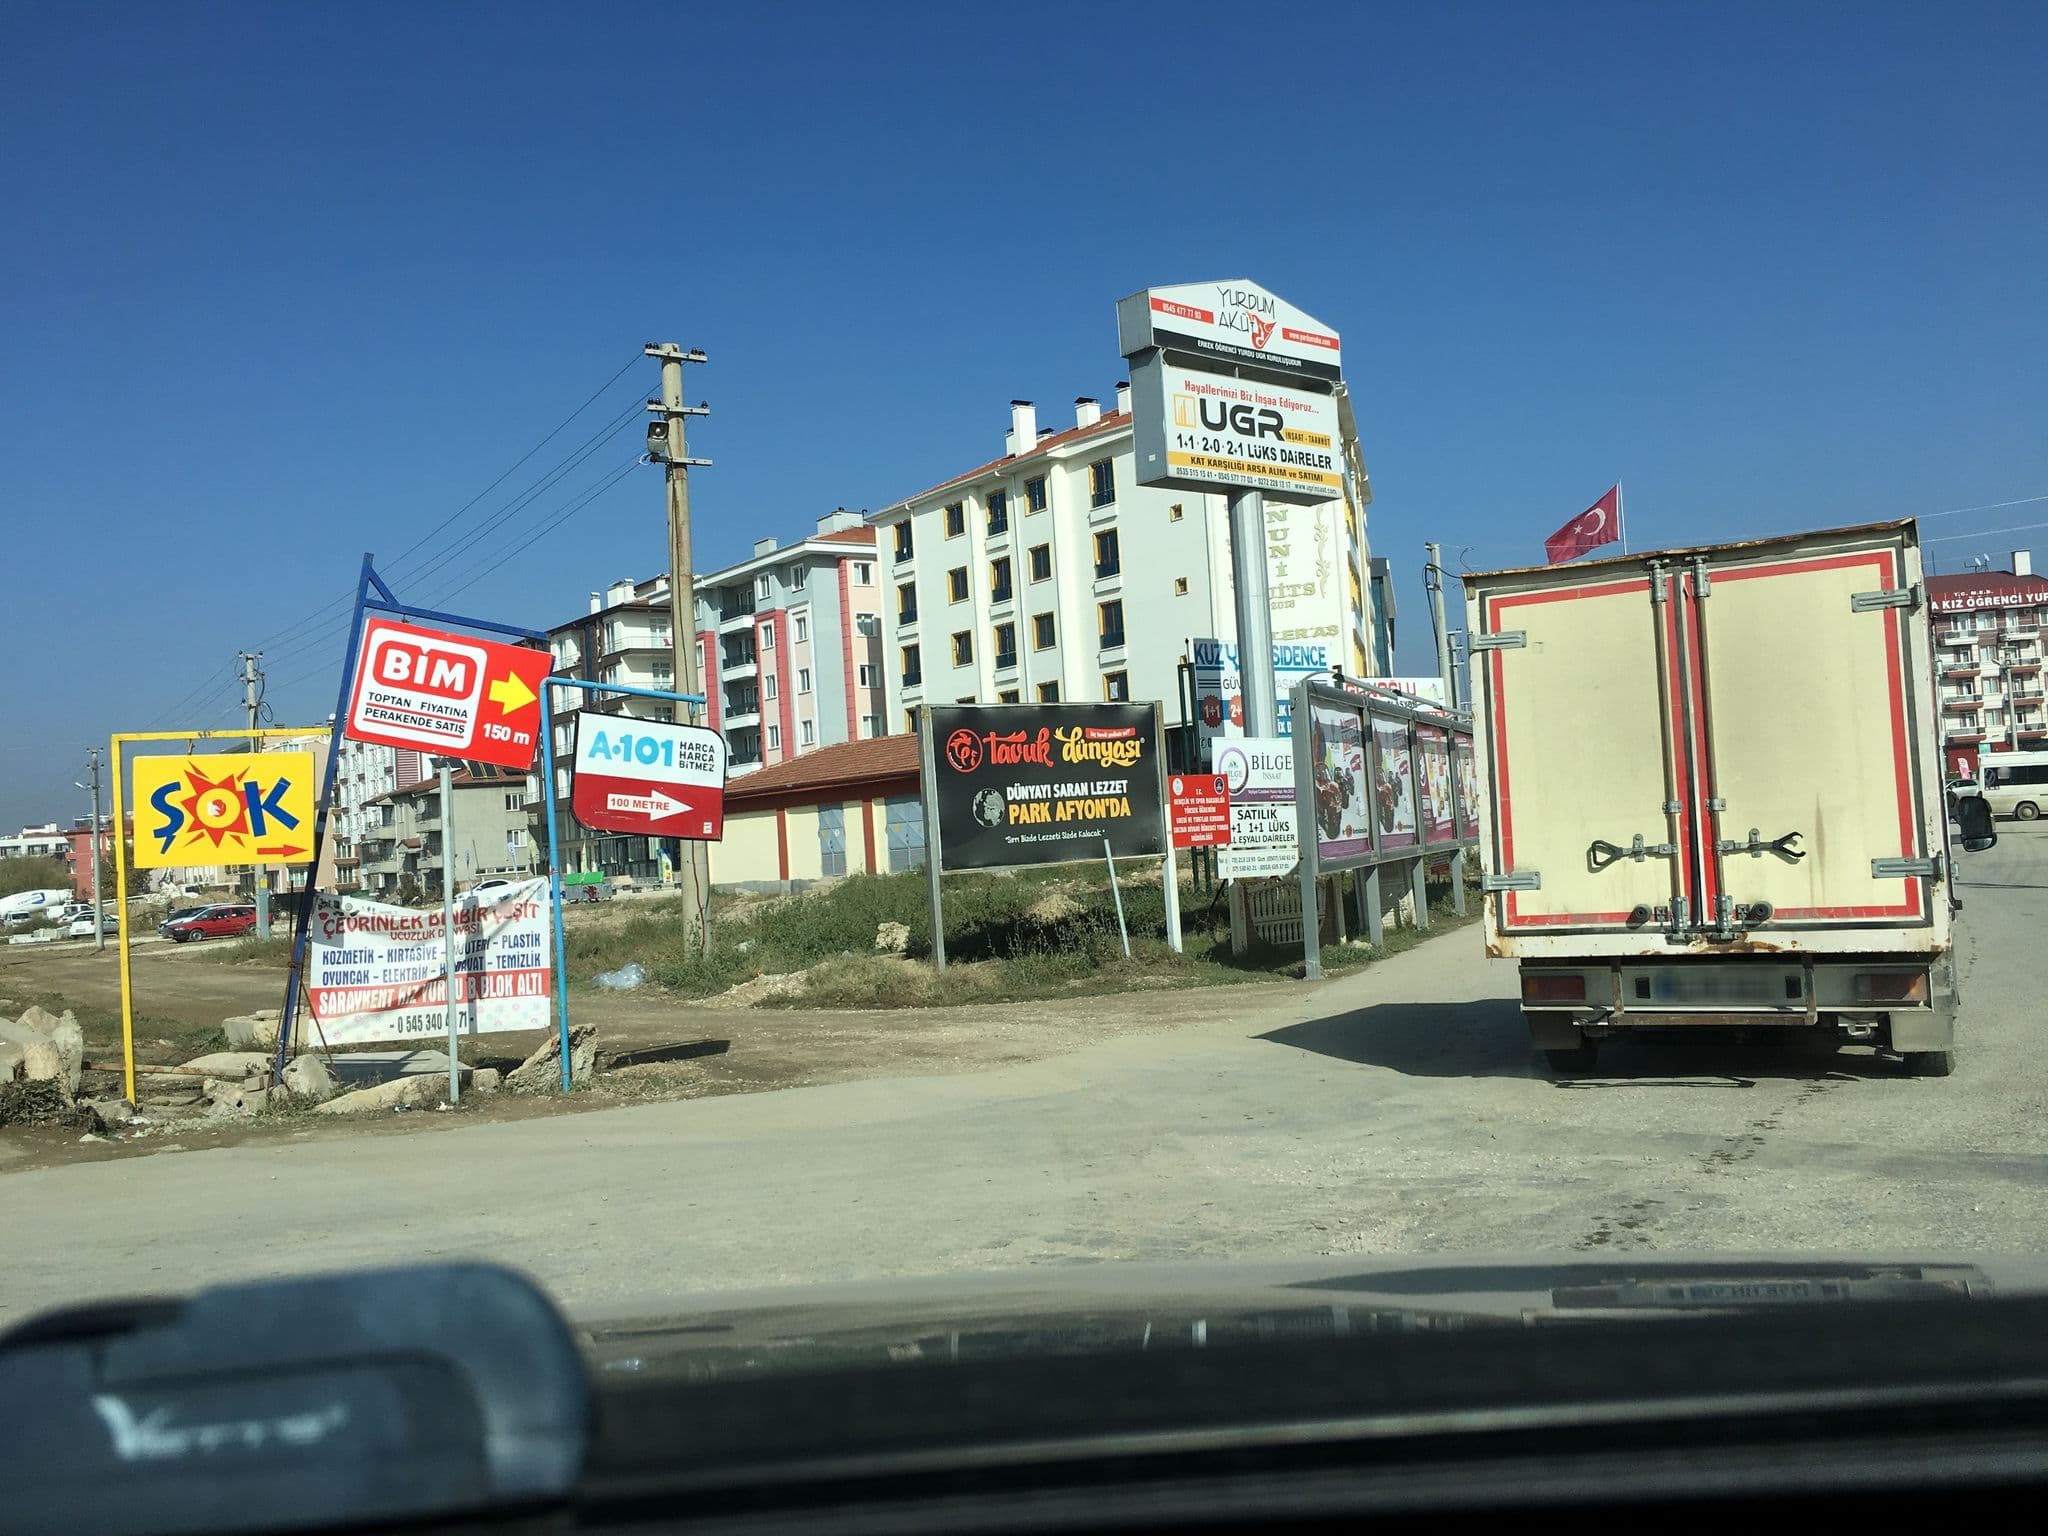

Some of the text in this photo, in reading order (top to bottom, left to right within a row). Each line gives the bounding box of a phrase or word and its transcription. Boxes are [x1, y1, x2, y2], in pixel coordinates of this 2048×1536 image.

[1216, 286, 1275, 319] YURDUM
[1184, 380, 1238, 399] Hayallerinizi
[1240, 390, 1252, 402] Biz
[1199, 398, 1285, 441] UGR
[1190, 456, 1205, 466] KAT
[1246, 463, 1266, 474] ARSA
[1269, 467, 1287, 477] ALIM
[1289, 471, 1297, 479] ve
[1298, 471, 1323, 482] SATIMI
[1942, 599, 1964, 610] KIZ
[1966, 593, 2022, 607] ÖĞRENCİ
[1271, 645, 1327, 667] SIDENCE
[368, 692, 468, 719] TOPTAN FİYATINA
[1203, 704, 1221, 719] 1+1
[364, 707, 465, 734] PERAKENDE SATIŞ
[483, 723, 530, 745] 150 m
[679, 740, 715, 754] HARCA
[679, 751, 714, 763] HARCA
[1251, 752, 1293, 770] BİLGE
[1006, 779, 1128, 801] DÜNYAYI SARAN LEZZET
[610, 797, 670, 811] 100 METRE
[1008, 796, 1131, 825] PARK AFYON'DA
[1237, 809, 1278, 820] SATILIK
[149, 776, 300, 855] ŞOK
[1248, 822, 1264, 833] 1+1
[1268, 820, 1290, 832] LÜKS
[1238, 834, 1261, 845] EŞYALI
[1262, 833, 1295, 843] DAİRELER
[390, 922, 480, 941] UCUZLUK DNYASI
[322, 946, 374, 966] KOZMETİK
[387, 943, 437, 963] KIRTASİYE
[502, 930, 541, 949] PLASTİK
[322, 968, 369, 986] OYUNCAK
[382, 965, 428, 983] ELEKTRİK
[496, 951, 541, 970] TEMİZLİK
[319, 989, 394, 1016] SARAYKENT
[421, 977, 464, 1004] YURU
[467, 977, 476, 998] B
[480, 974, 513, 998] BLOK
[517, 973, 543, 995] ALTI
[406, 1014, 423, 1032] 545
[425, 1012, 442, 1031] 340
